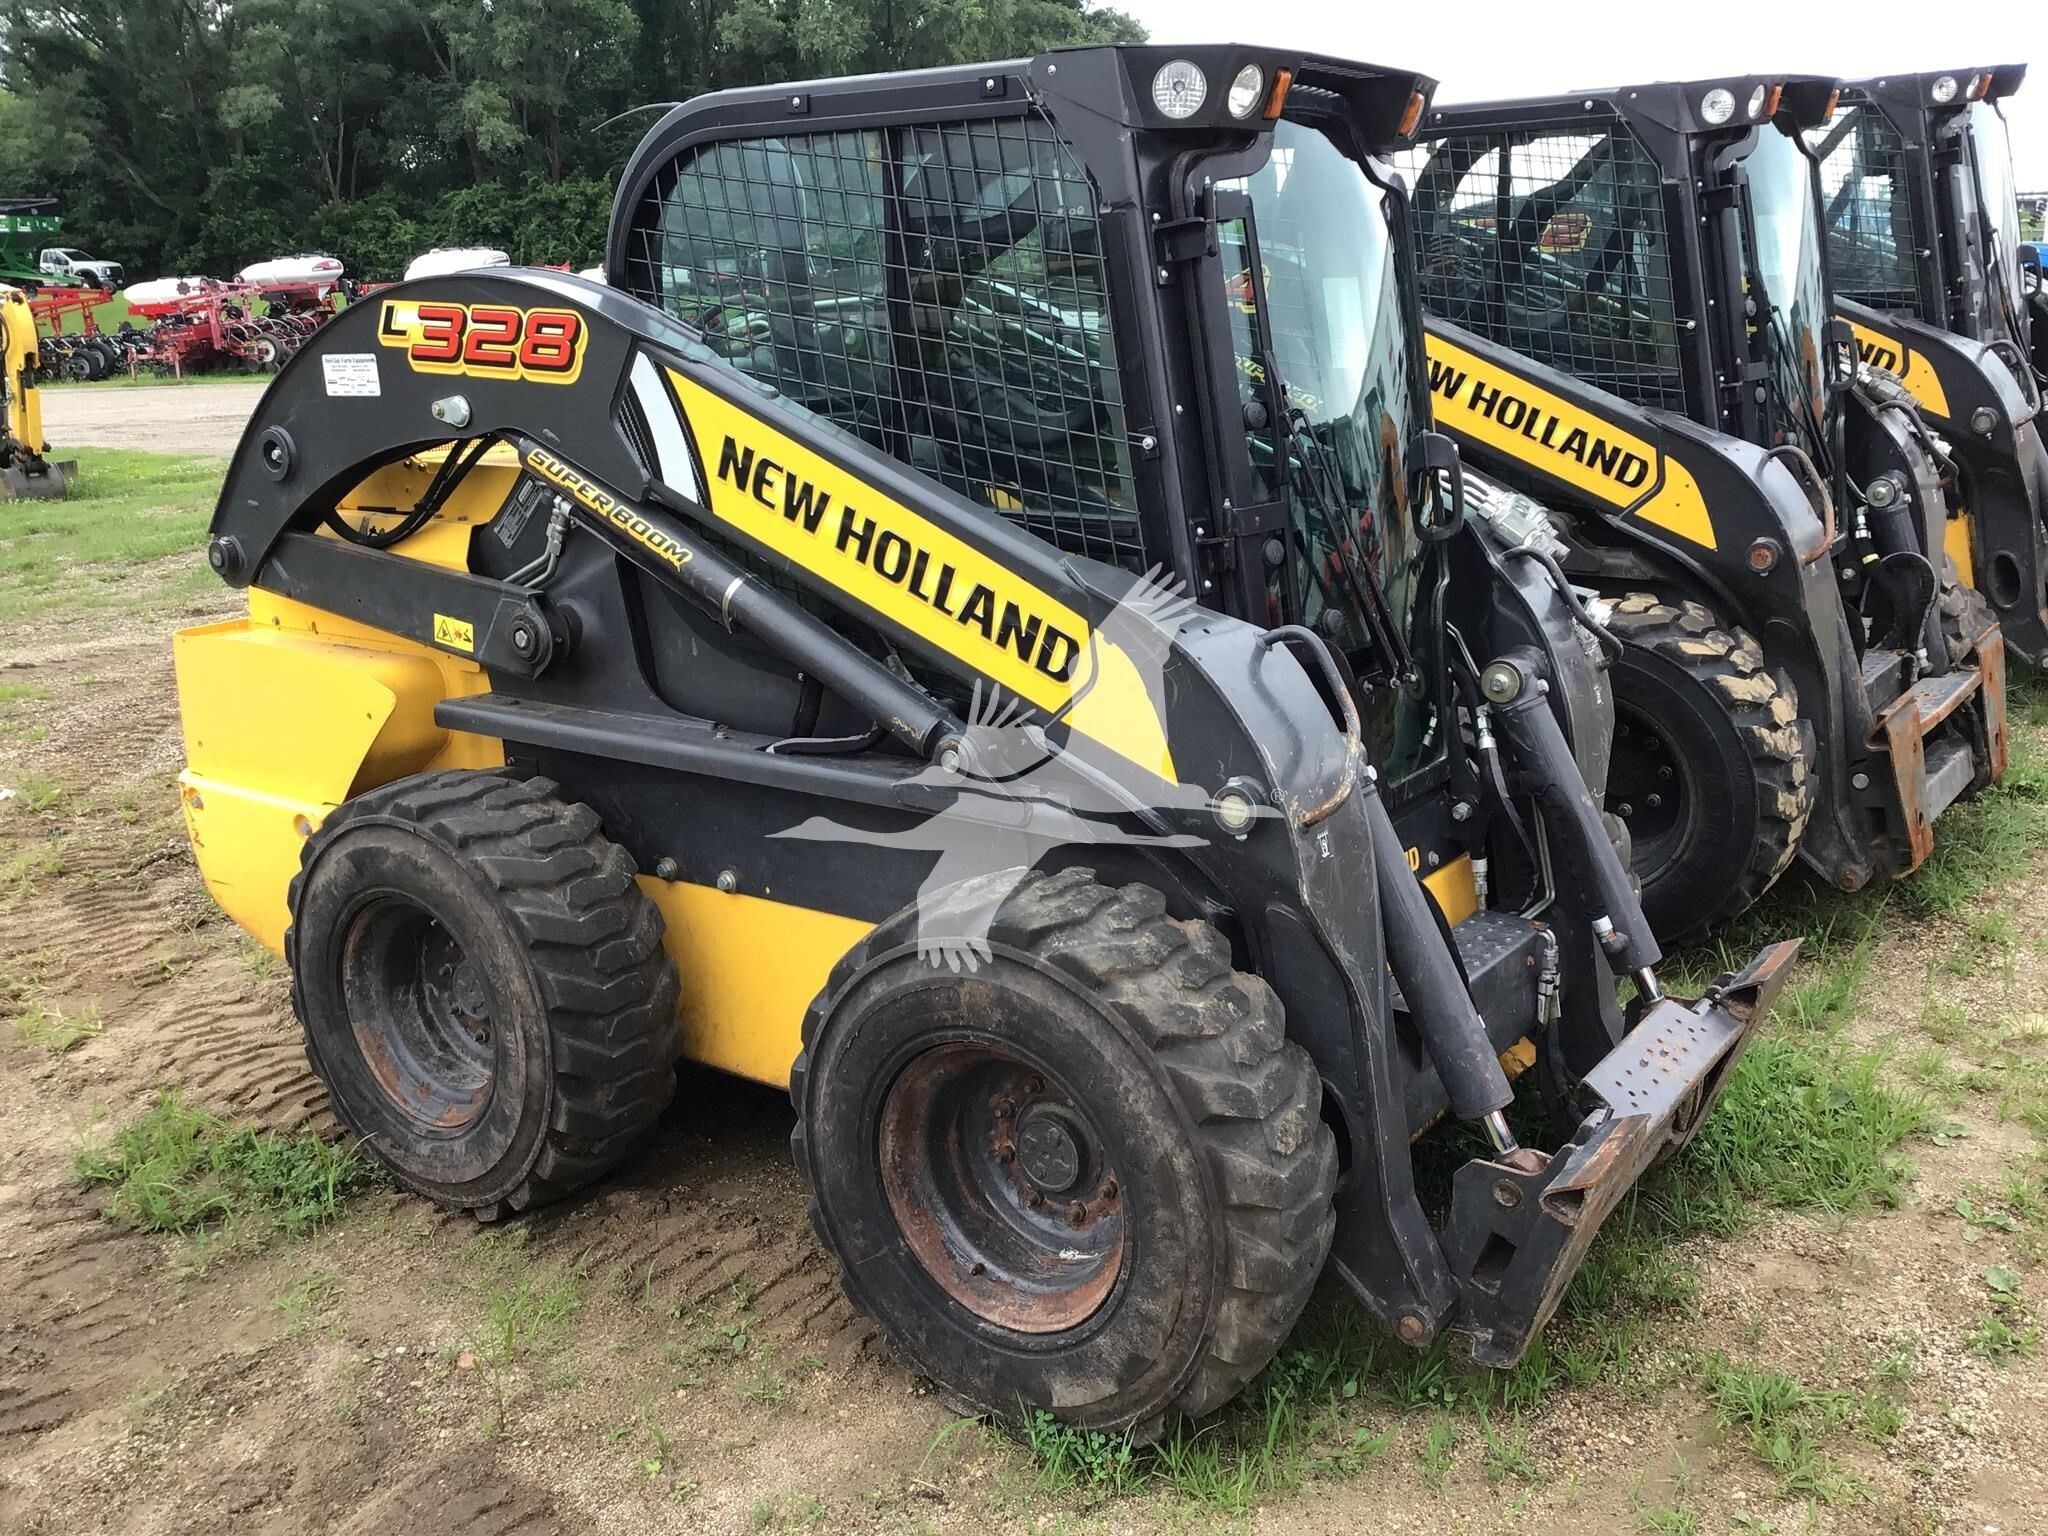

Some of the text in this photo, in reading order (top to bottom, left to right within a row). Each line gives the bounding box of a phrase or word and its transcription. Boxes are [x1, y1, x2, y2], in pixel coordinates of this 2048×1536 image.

[1467, 380, 1649, 488] HOLLAND
[528, 449, 616, 516] SUPER
[610, 504, 693, 566] BOOM
[717, 434, 1081, 684] NEW HOLLAND
